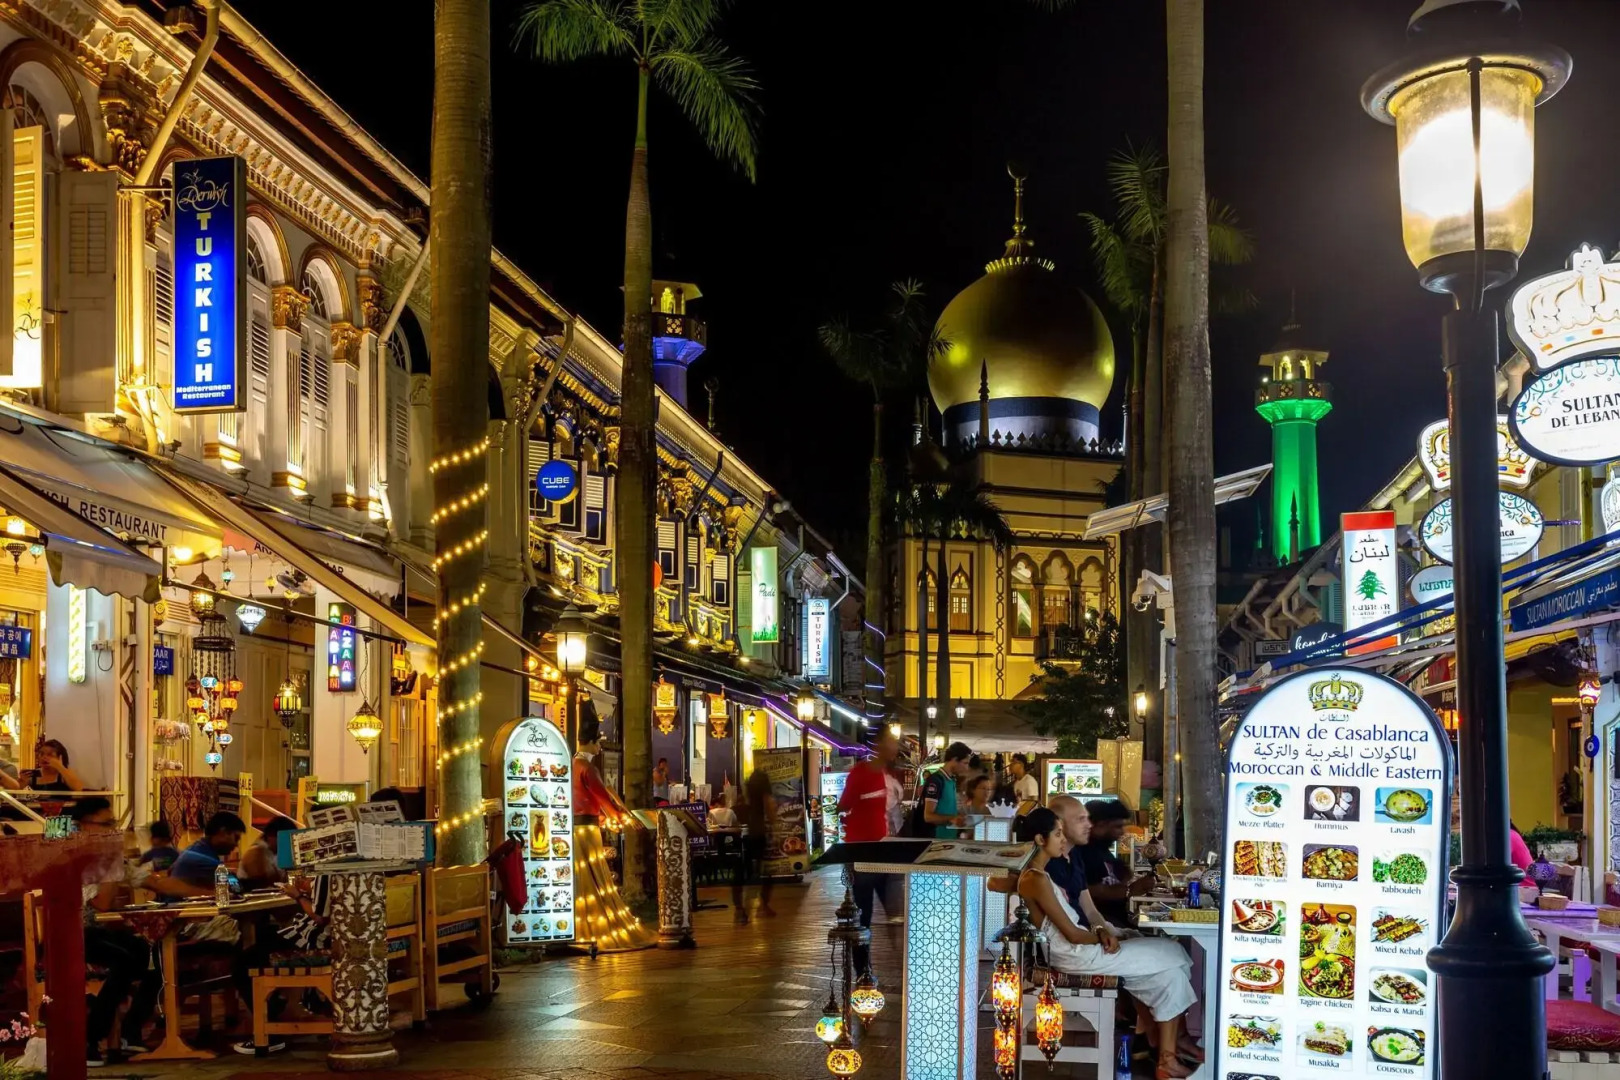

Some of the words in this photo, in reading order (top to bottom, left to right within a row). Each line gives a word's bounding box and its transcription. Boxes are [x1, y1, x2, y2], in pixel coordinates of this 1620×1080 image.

[195, 212, 213, 383] TURKISH
[176, 384, 231, 393] Mediterranean
[182, 391, 225, 399] Restaurant
[1551, 416, 1570, 428] DE
[542, 476, 570, 485] CUBE
[79, 501, 167, 540] RESTAURANT
[1349, 545, 1390, 563] لبنان
[759, 583, 776, 597] Padi
[1547, 587, 1586, 618] MOROCCAN
[1243, 725, 1300, 738] SULTAN
[1307, 723, 1328, 740] de
[1335, 724, 1429, 742] Casablanca
[1229, 762, 1304, 776] Moroccan
[1311, 764, 1321, 776] &
[1329, 762, 1379, 778] Middle
[1386, 766, 1442, 780] Eastern
[1263, 820, 1285, 828] Platter
[1390, 826, 1415, 834] Lavash
[1316, 881, 1343, 891] Bamiya
[1382, 886, 1421, 895] Tabbouleh
[1251, 936, 1282, 945] Magharbi
[1375, 946, 1396, 954] Mixed
[1300, 999, 1322, 1007] Tagine
[1325, 1001, 1352, 1009] Chicken
[1402, 1008, 1424, 1016] Mandi
[1230, 1052, 1251, 1060] Grilled
[1253, 1054, 1279, 1062] Seabass
[1309, 1059, 1339, 1068] Musakka
[1377, 1065, 1414, 1074] Couscous
